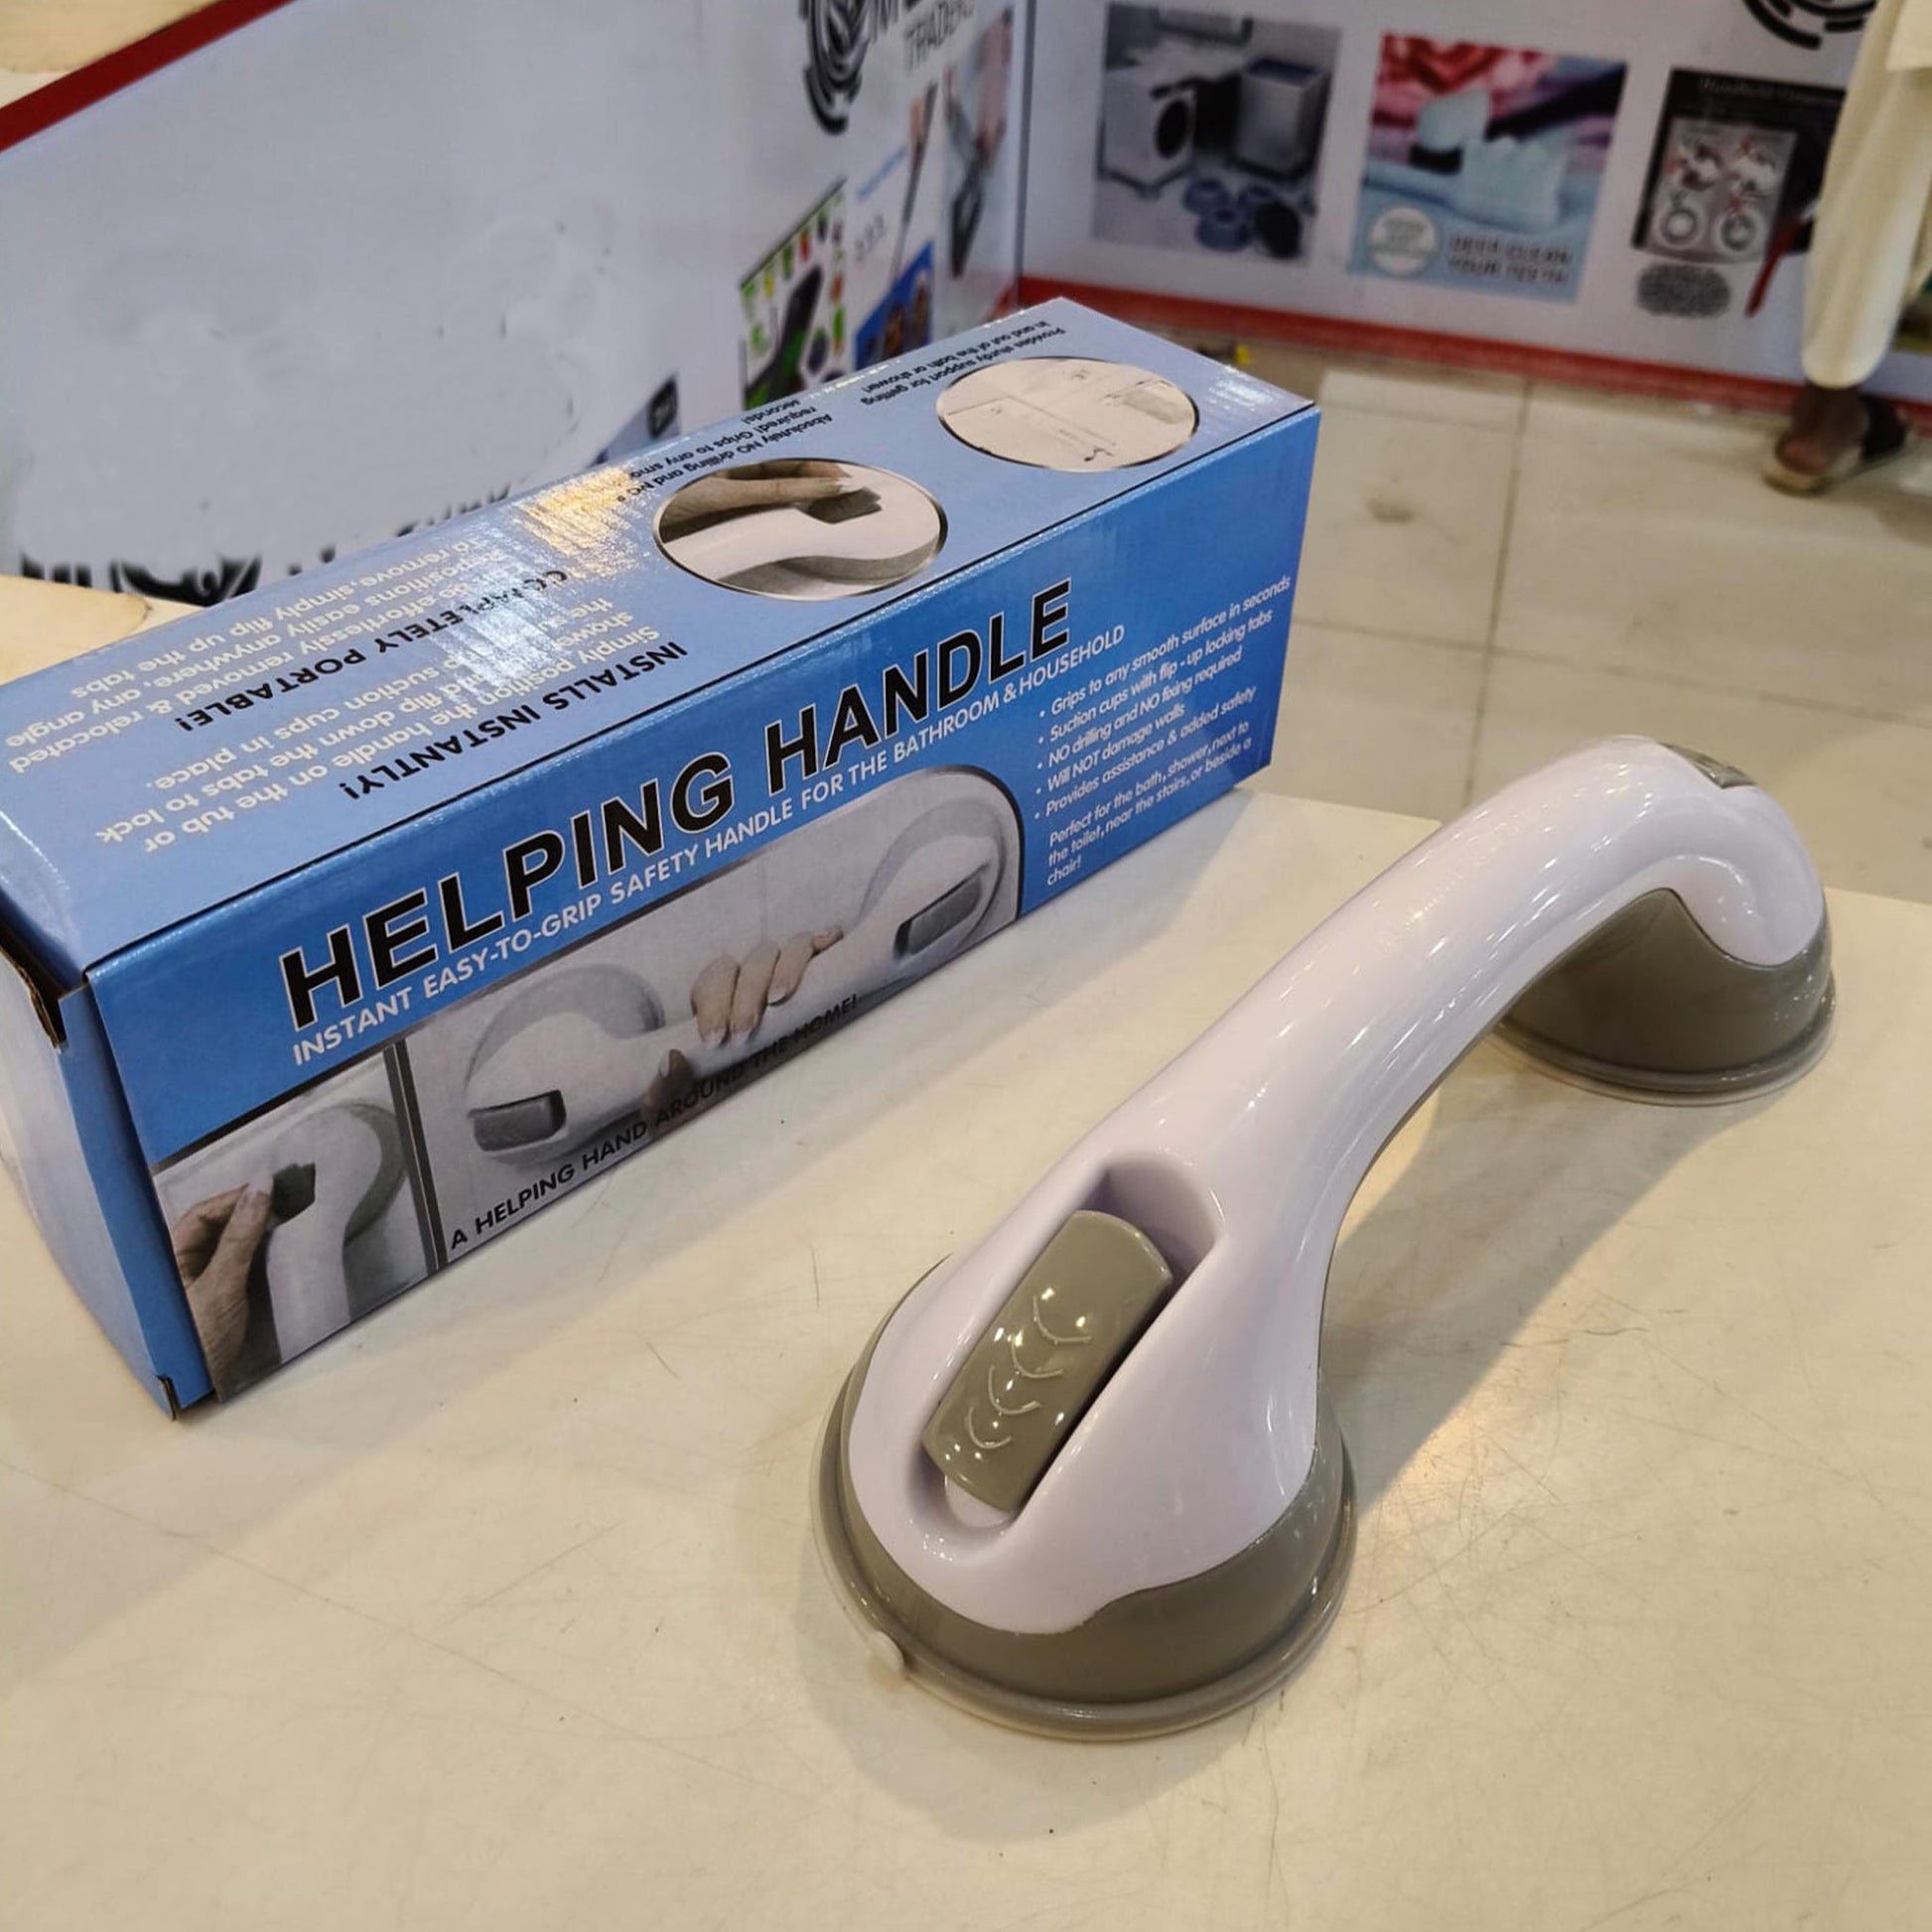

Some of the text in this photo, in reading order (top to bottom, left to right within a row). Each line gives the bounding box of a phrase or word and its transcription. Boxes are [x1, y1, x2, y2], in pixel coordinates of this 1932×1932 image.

[1009, 325, 1037, 338] and
[907, 376, 933, 389] for
[910, 364, 929, 374] or
[740, 398, 801, 425] seconds!
[752, 405, 818, 434] required!
[759, 412, 833, 443] Absolutely
[693, 443, 716, 455] to
[710, 429, 755, 448] Grips
[734, 440, 764, 454] NO
[662, 450, 696, 466] any
[681, 450, 736, 473] drilling
[650, 469, 685, 486] and
[225, 615, 275, 638] flip
[285, 603, 361, 637] easily
[297, 594, 438, 655] effortlessly
[185, 632, 227, 653] up
[575, 624, 660, 664] Simply
[1050, 574, 1291, 716] Grips to any smooth surface in seconds
[134, 648, 188, 673] the
[141, 632, 283, 688] anywhere,
[541, 640, 688, 711] INSTALLS
[1049, 705, 1097, 743] Suction
[1098, 687, 1129, 715] cups
[1129, 669, 1157, 696] with
[1158, 658, 1178, 683] flip
[1185, 646, 1203, 668] up
[1203, 622, 1246, 656] locking
[1246, 607, 1274, 633] tabs
[69, 668, 136, 699] tabs
[143, 597, 614, 790] the suction cups in place.
[174, 650, 295, 706] removed
[174, 647, 366, 732] PORTABLE!
[472, 655, 578, 706] position
[87, 686, 143, 715] any
[143, 697, 175, 716] &
[394, 689, 444, 715] flip
[427, 701, 480, 728] the
[1047, 643, 1243, 767] NO drilling and NO fixing required
[1, 708, 88, 749] angle
[7, 709, 145, 773] relocated
[317, 710, 396, 747] down
[330, 721, 433, 767] handle
[266, 742, 320, 768] the
[338, 703, 541, 800] INSTANTLY!
[1044, 683, 1257, 817] Provides assistance & added safety
[1046, 701, 1185, 792] Will NOT damage walls
[200, 762, 269, 797] tabs
[286, 763, 330, 787] on
[1048, 810, 1093, 848] Perfect
[1093, 799, 1112, 822] for
[1112, 787, 1134, 810] the
[1210, 725, 1237, 752] next
[1236, 718, 1250, 737] to
[163, 791, 201, 813] to
[232, 781, 290, 811] the
[279, 578, 1072, 1031] HELPING HANDLE
[1047, 845, 1068, 868] the
[1134, 792, 1155, 815] the
[1203, 742, 1241, 773] beside
[1242, 735, 1252, 751] a
[93, 807, 166, 843] lock
[178, 804, 236, 835] tub
[141, 829, 178, 853] or
[292, 623, 1125, 1066] INSTANT EASY-TO-GRIP SAFETY HANDLE FOR THE BATHROOM & HOUSEHOLD
[1045, 853, 1082, 887] chair!
[449, 992, 858, 1251] A HELPING HAND AROUND THE HOME!
